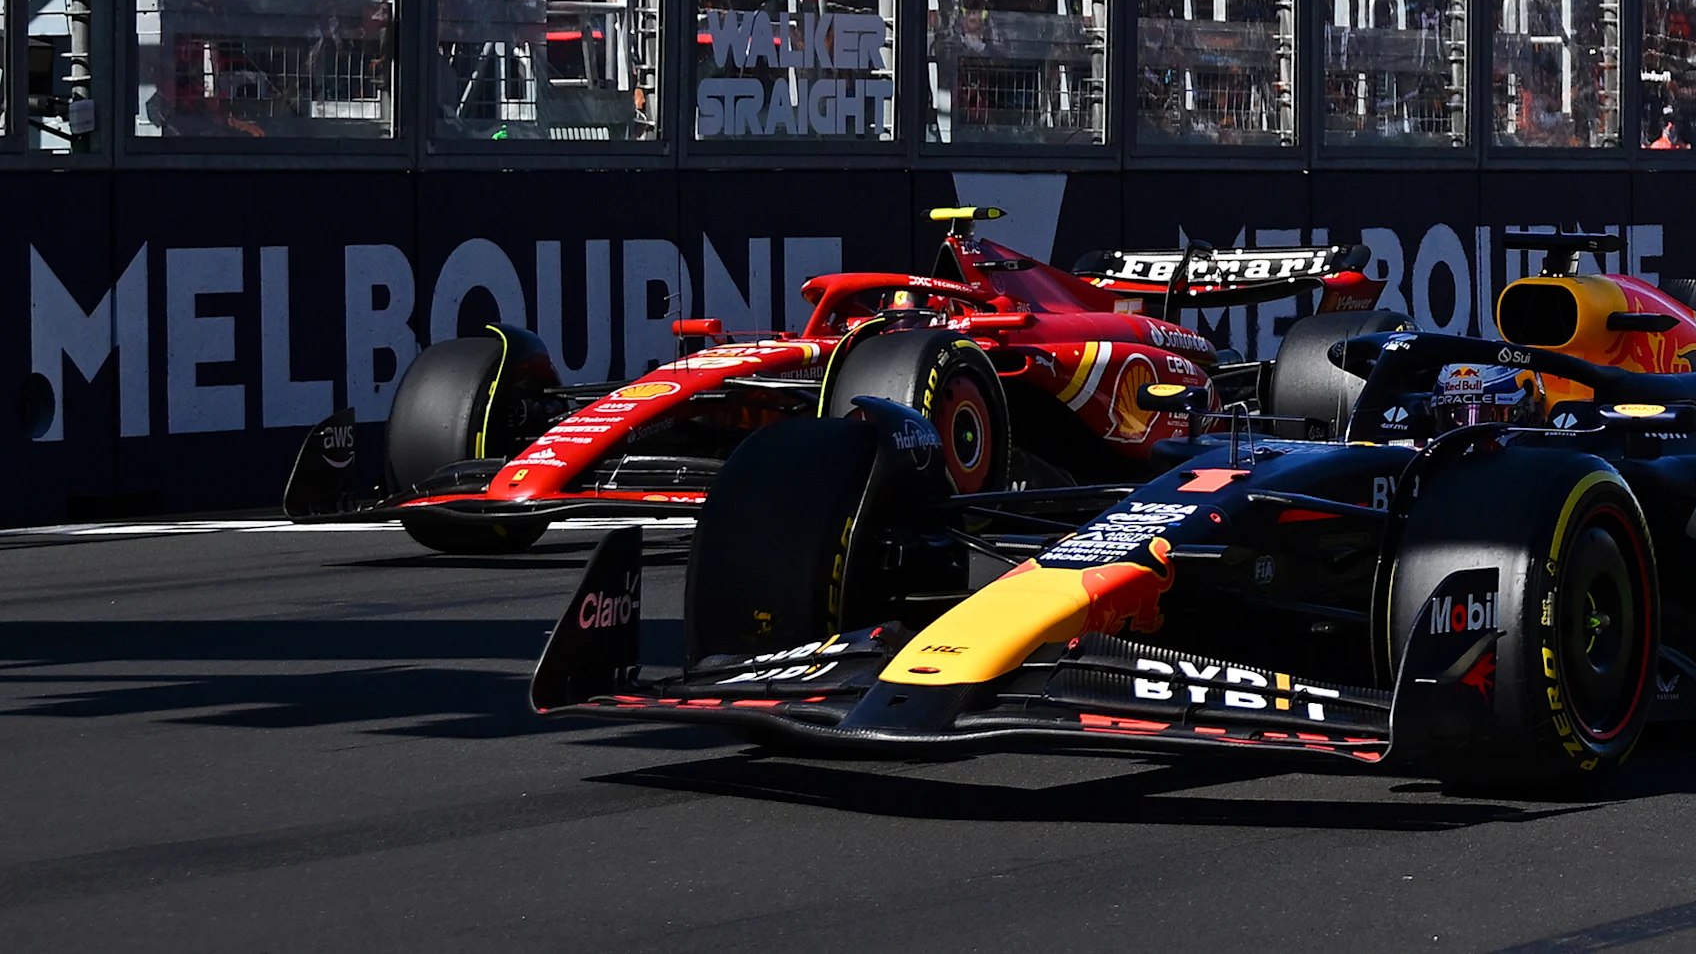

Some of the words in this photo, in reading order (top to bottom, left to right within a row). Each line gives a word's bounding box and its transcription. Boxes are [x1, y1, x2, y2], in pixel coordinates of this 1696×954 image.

[707, 11, 886, 68] WALKER
[697, 78, 894, 135] STRAIGHT
[1119, 250, 1330, 282] Ferrari
[1337, 296, 1373, 310] V-Power
[1513, 352, 1531, 365] Sui
[780, 365, 824, 380] RICHARD
[1444, 380, 1461, 393] Red
[1462, 379, 1482, 392] Bull
[1437, 394, 1493, 405] ORACLE
[323, 425, 355, 450] aws
[637, 417, 676, 440] Santander
[1177, 468, 1251, 493] 1
[1130, 502, 1198, 515] VISA
[1088, 523, 1166, 533] zoom
[1040, 553, 1098, 562] Mobil
[1051, 547, 1128, 556] infinitum
[579, 591, 632, 629] Claro
[1430, 592, 1500, 634] Mobil
[921, 645, 969, 654] HRC
[1134, 658, 1340, 721] BYBIT
[1541, 646, 1584, 758] ZERO
